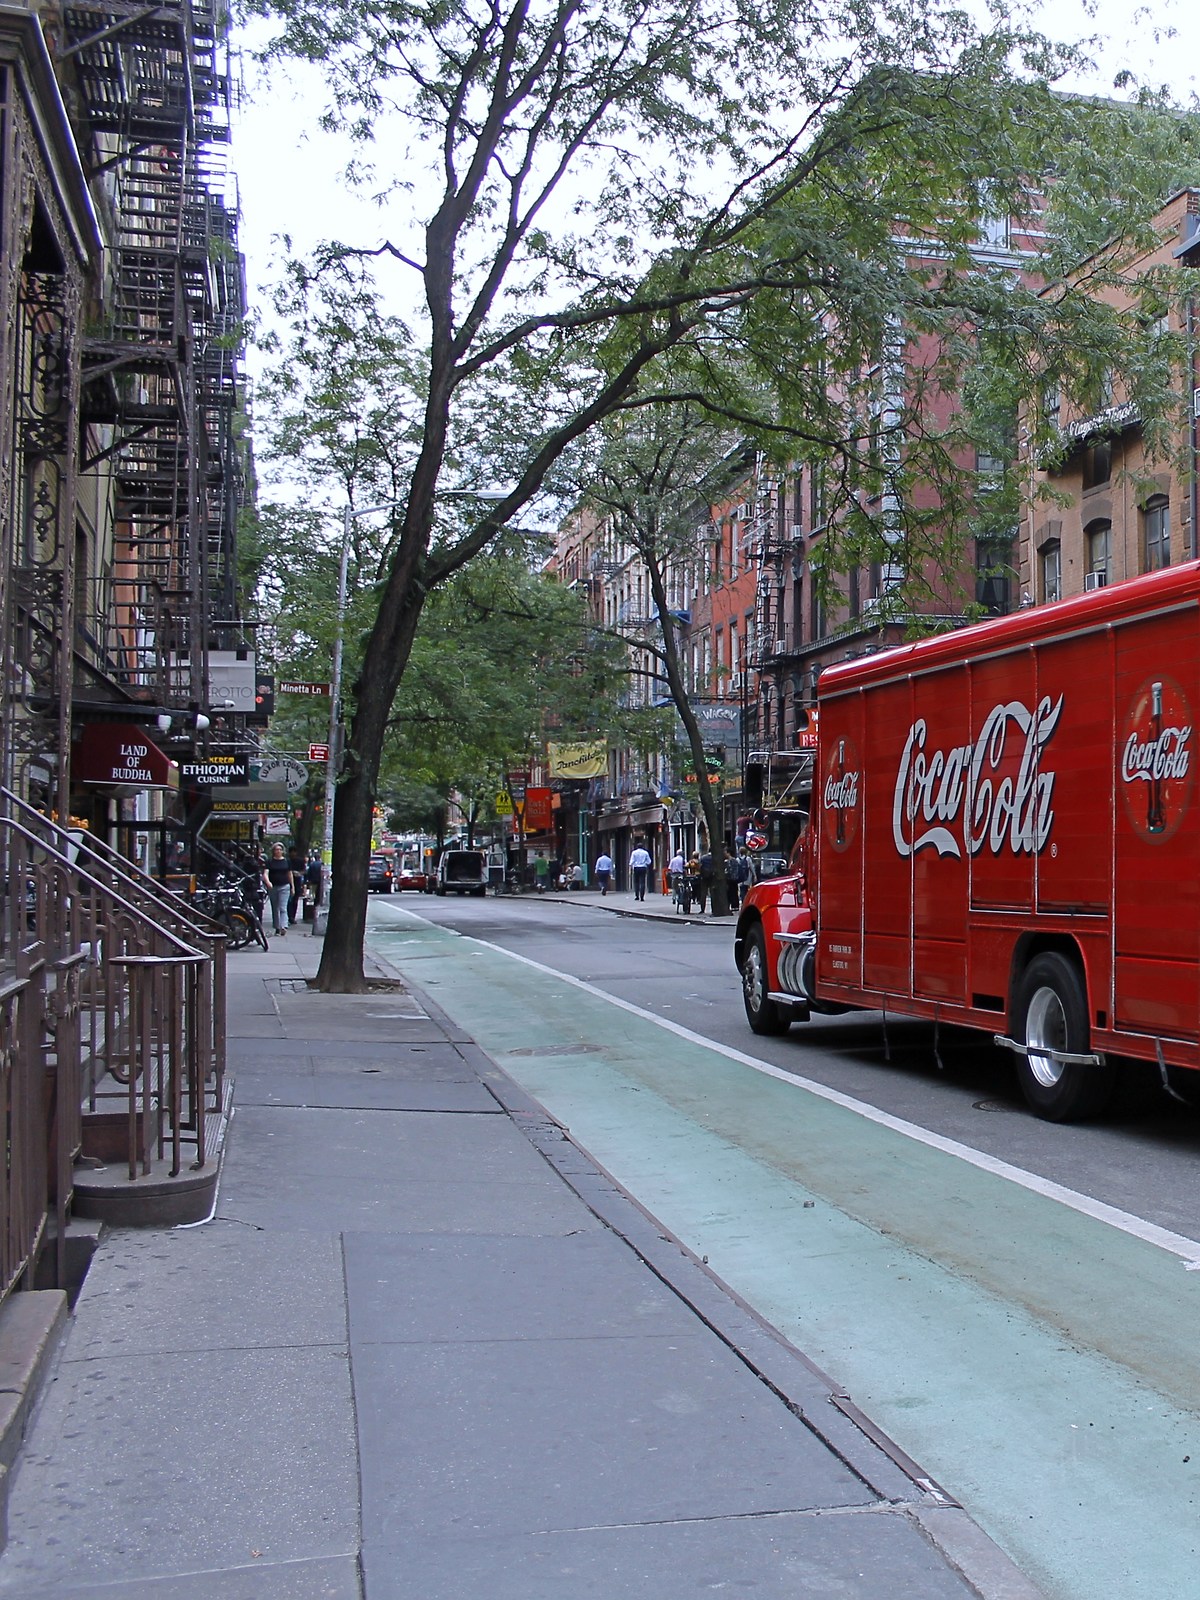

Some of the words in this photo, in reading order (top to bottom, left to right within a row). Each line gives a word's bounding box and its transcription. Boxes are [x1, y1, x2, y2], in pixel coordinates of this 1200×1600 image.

[208, 686, 251, 698] ROTTO
[280, 683, 310, 695] Minetta
[312, 686, 322, 695] Ln
[121, 744, 147, 756] LAND
[1121, 725, 1192, 782] Coca-Cola
[127, 756, 140, 768] OF
[112, 767, 152, 781] BUDDHA
[182, 764, 245, 775] ETHIOPIAN
[261, 761, 280, 778] LUXOR
[282, 760, 306, 778] LOUNGE
[197, 775, 229, 784] CUISINE
[893, 692, 1064, 859] Coca-Cola
[824, 770, 860, 810] Coca-Cola
[257, 801, 267, 811] ALE
[268, 801, 286, 811] HOUSE
